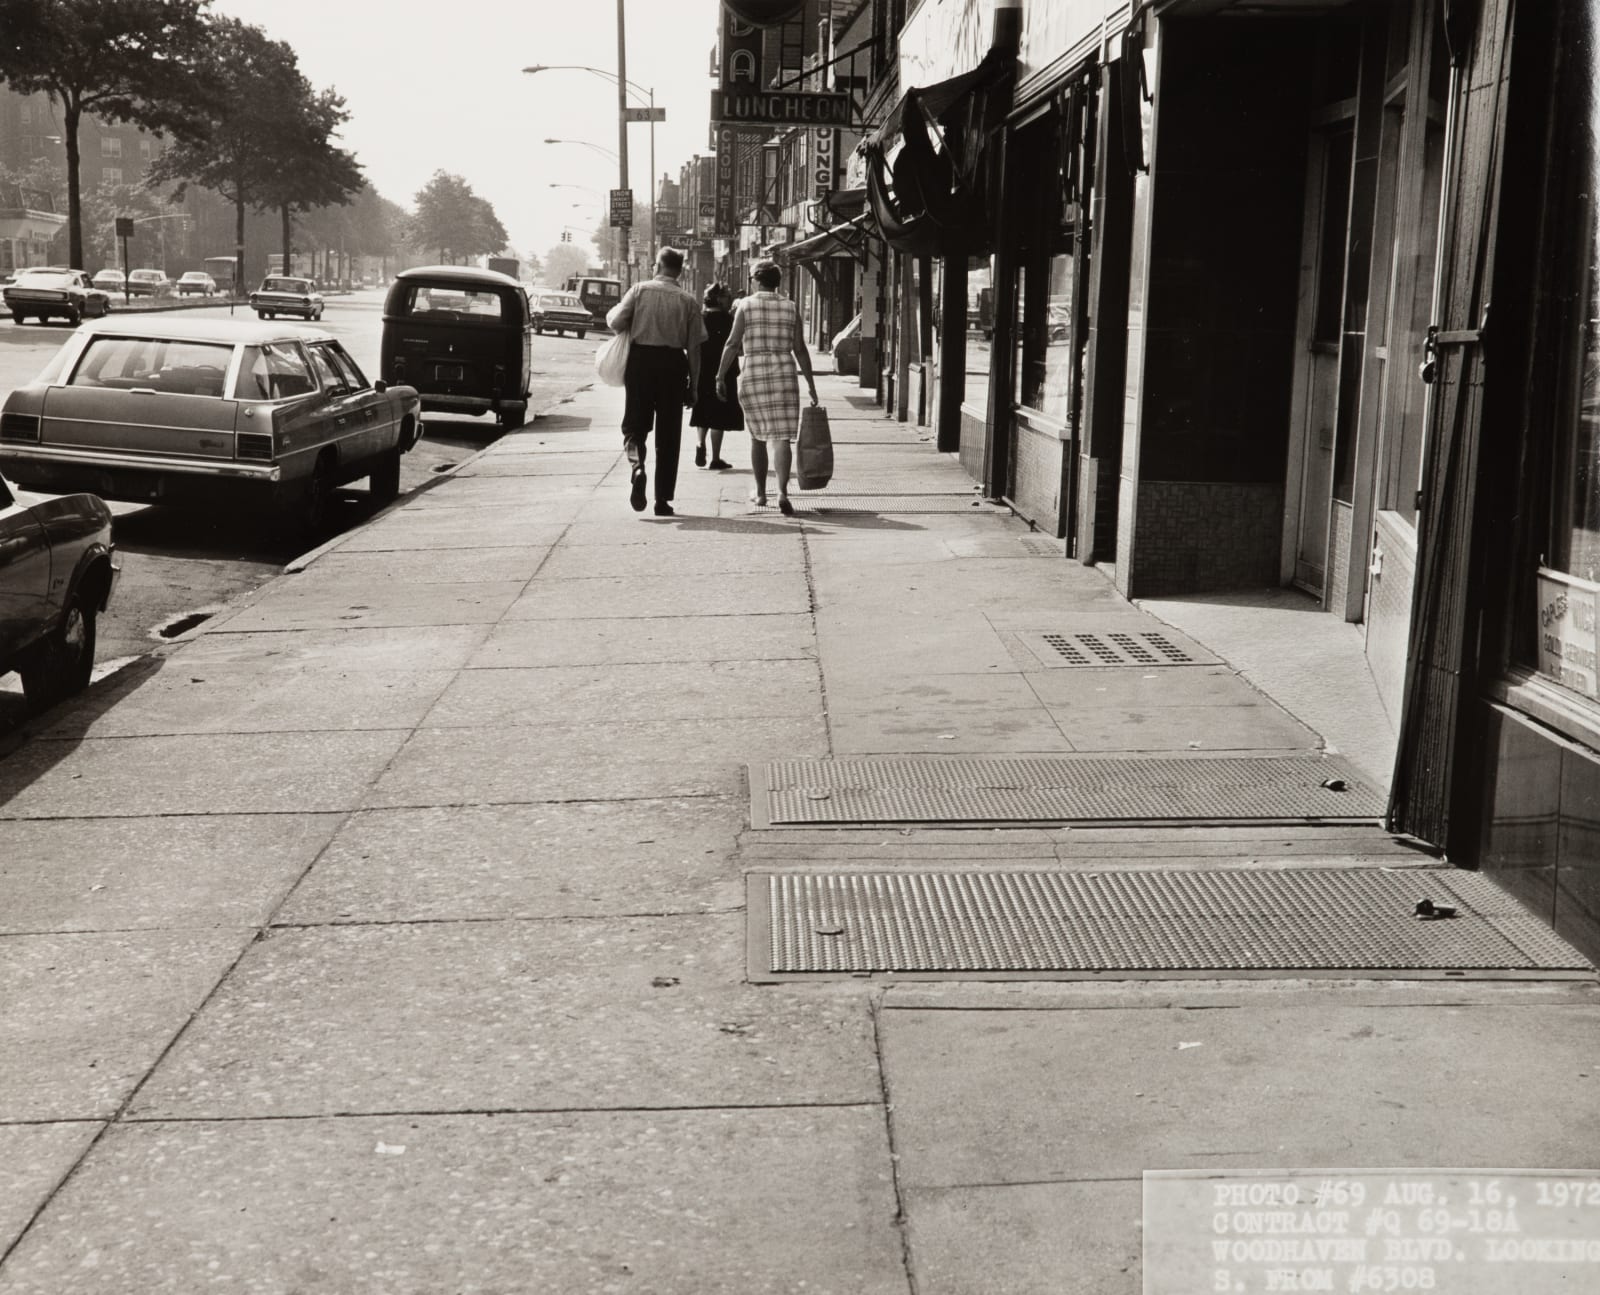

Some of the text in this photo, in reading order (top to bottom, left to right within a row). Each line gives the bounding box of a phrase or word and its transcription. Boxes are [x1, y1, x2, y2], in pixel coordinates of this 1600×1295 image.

[723, 95, 846, 119] LUNCHEON
[720, 129, 732, 234] CHOW MEIN
[815, 126, 832, 198] OUNGE
